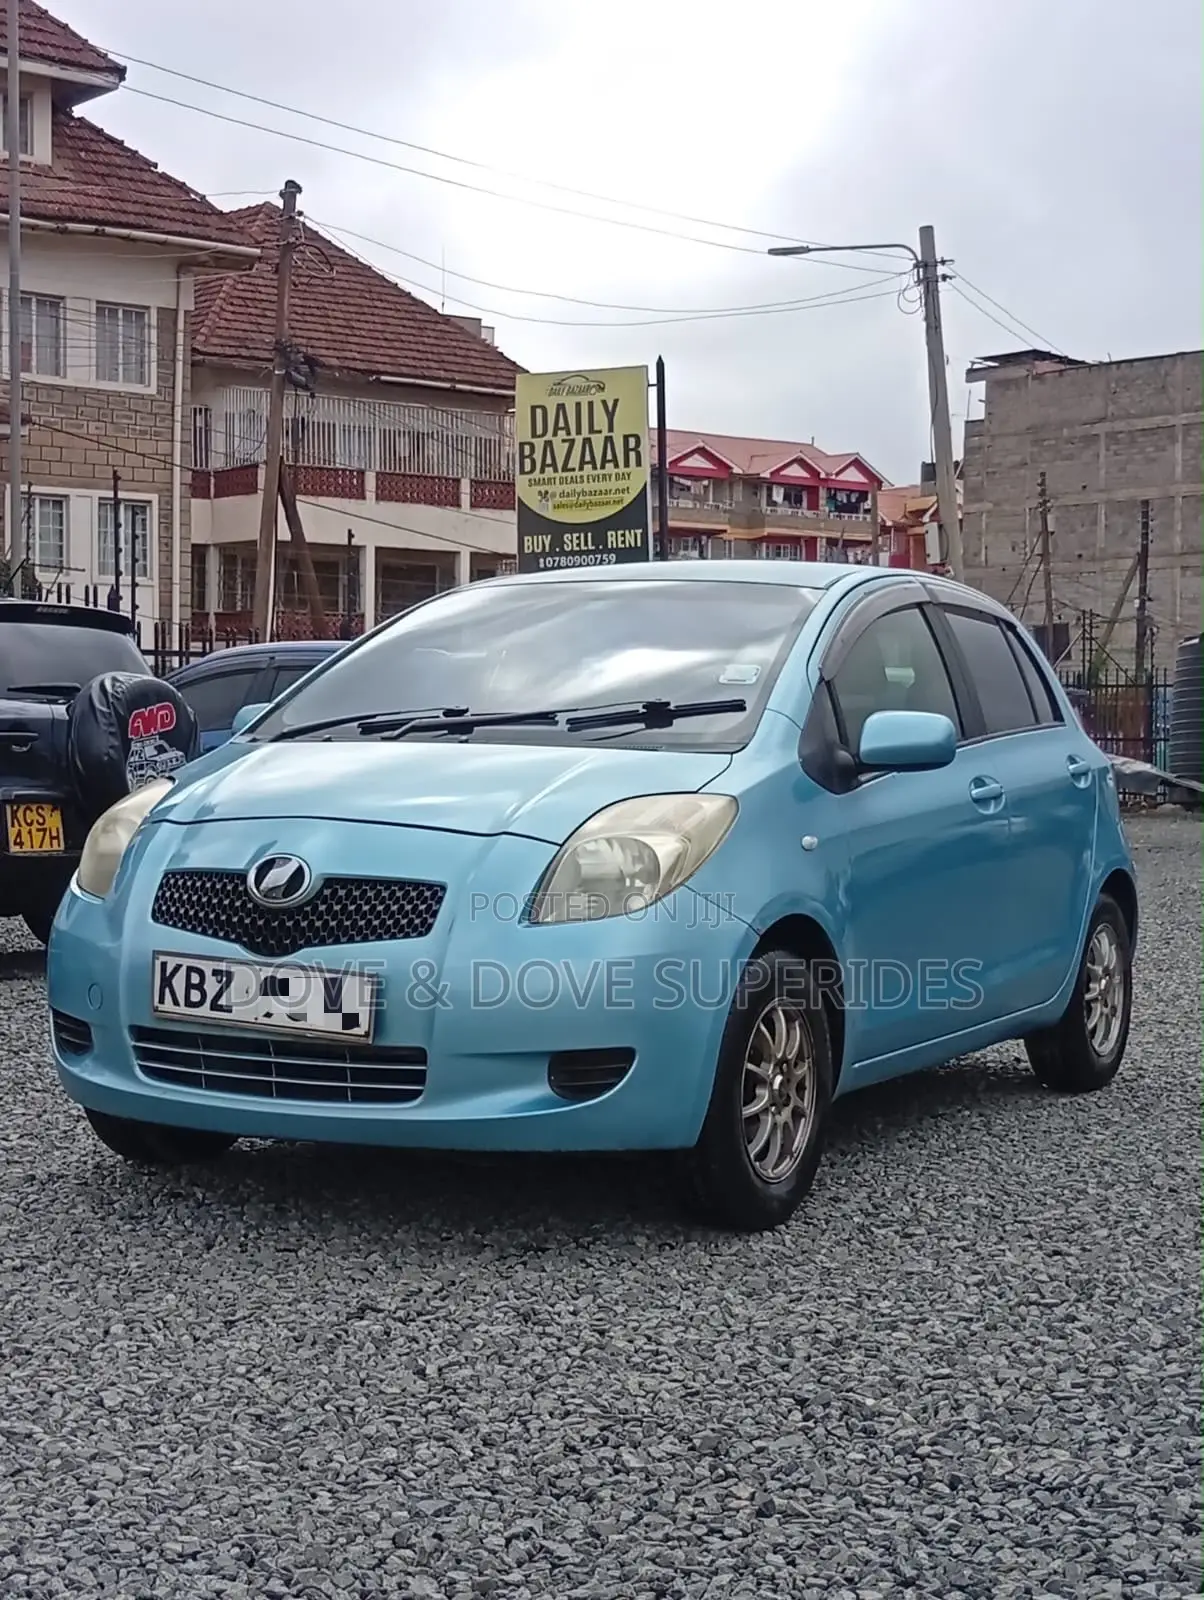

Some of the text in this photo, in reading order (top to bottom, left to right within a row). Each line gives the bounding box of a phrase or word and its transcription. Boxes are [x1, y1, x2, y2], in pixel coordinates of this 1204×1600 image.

[530, 398, 620, 439] DAILY
[518, 433, 642, 475] BAZAAR
[528, 472, 632, 487] SMART DEALS EVERY DAY
[559, 486, 630, 501] dailybazaar.net
[523, 534, 552, 553] BUY
[563, 532, 595, 551] SELL
[607, 529, 643, 549] RENT
[545, 553, 617, 568] 0780900759
[10, 804, 47, 828] KCS
[13, 828, 61, 850] 417H
[158, 960, 235, 1014] KBZ
